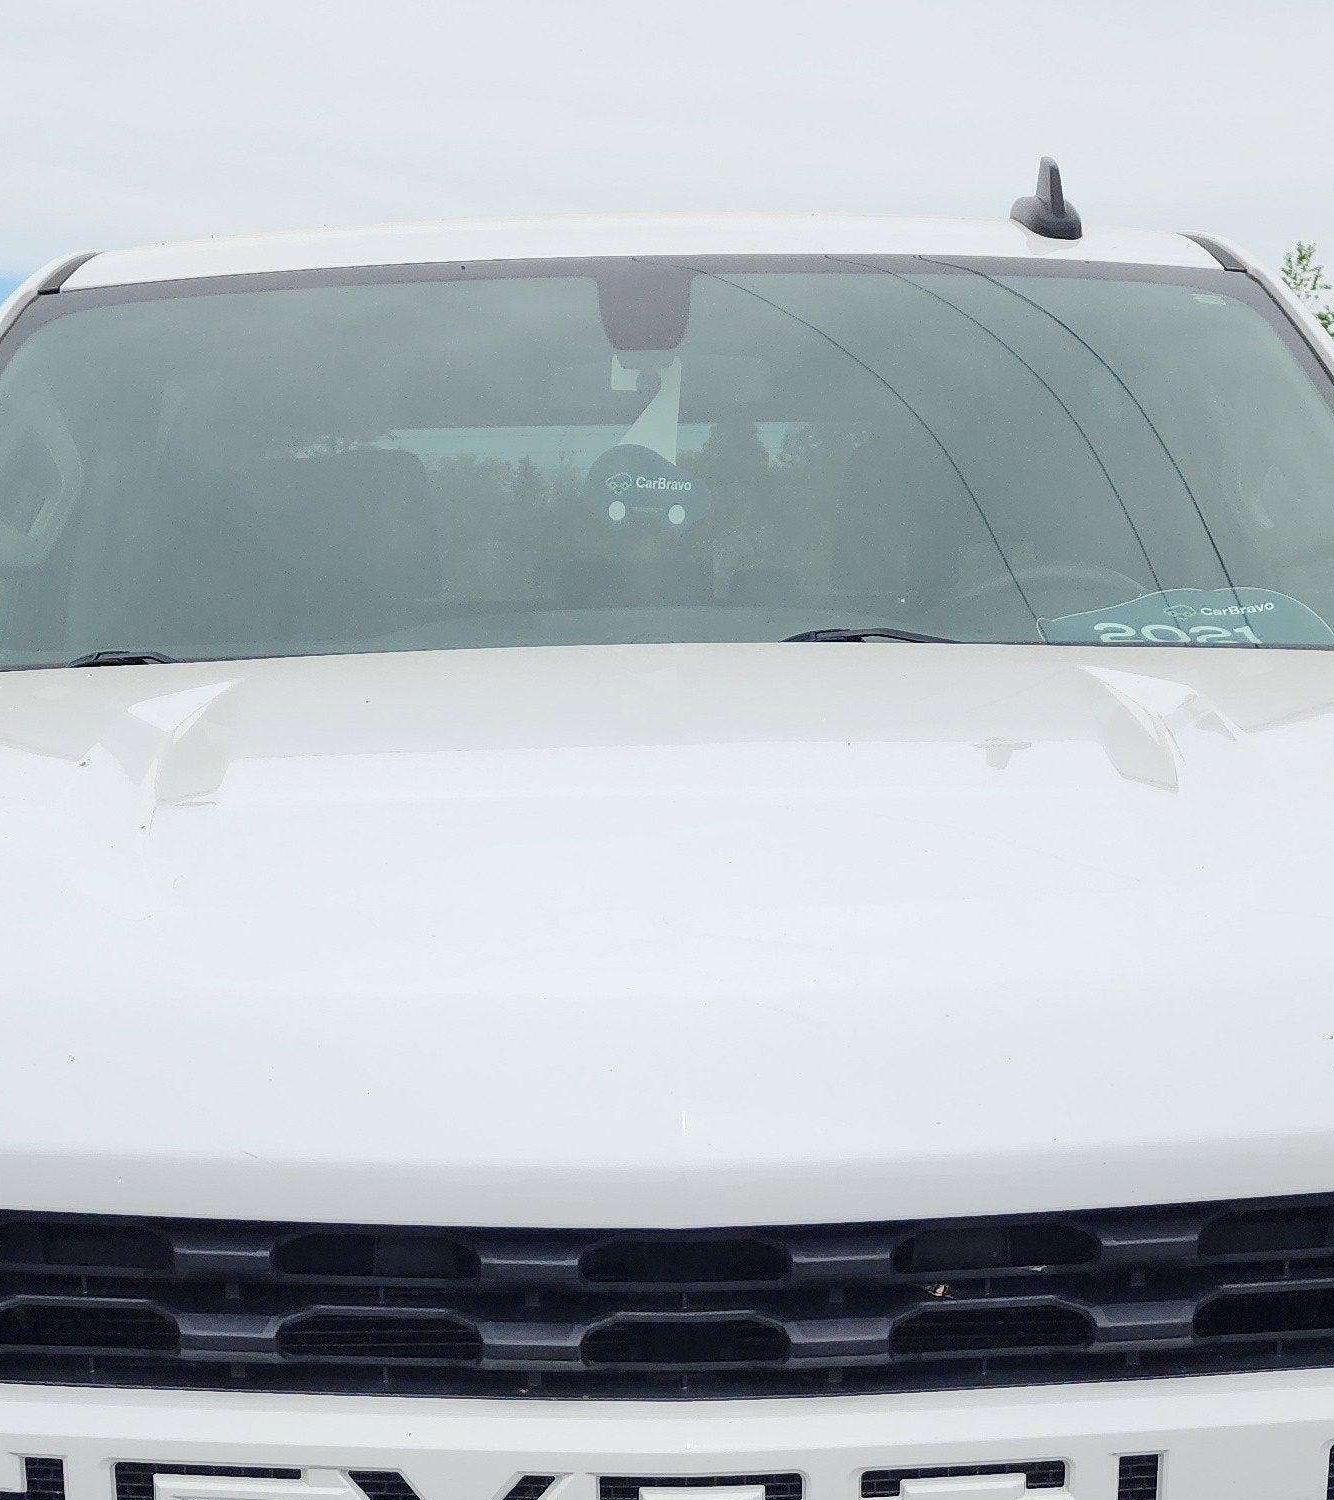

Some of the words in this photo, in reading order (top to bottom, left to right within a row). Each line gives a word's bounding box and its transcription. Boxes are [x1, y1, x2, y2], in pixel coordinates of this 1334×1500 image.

[636, 476, 692, 491] CarBravo
[1200, 601, 1275, 616] CarBravo
[1094, 622, 1263, 644] 2021
